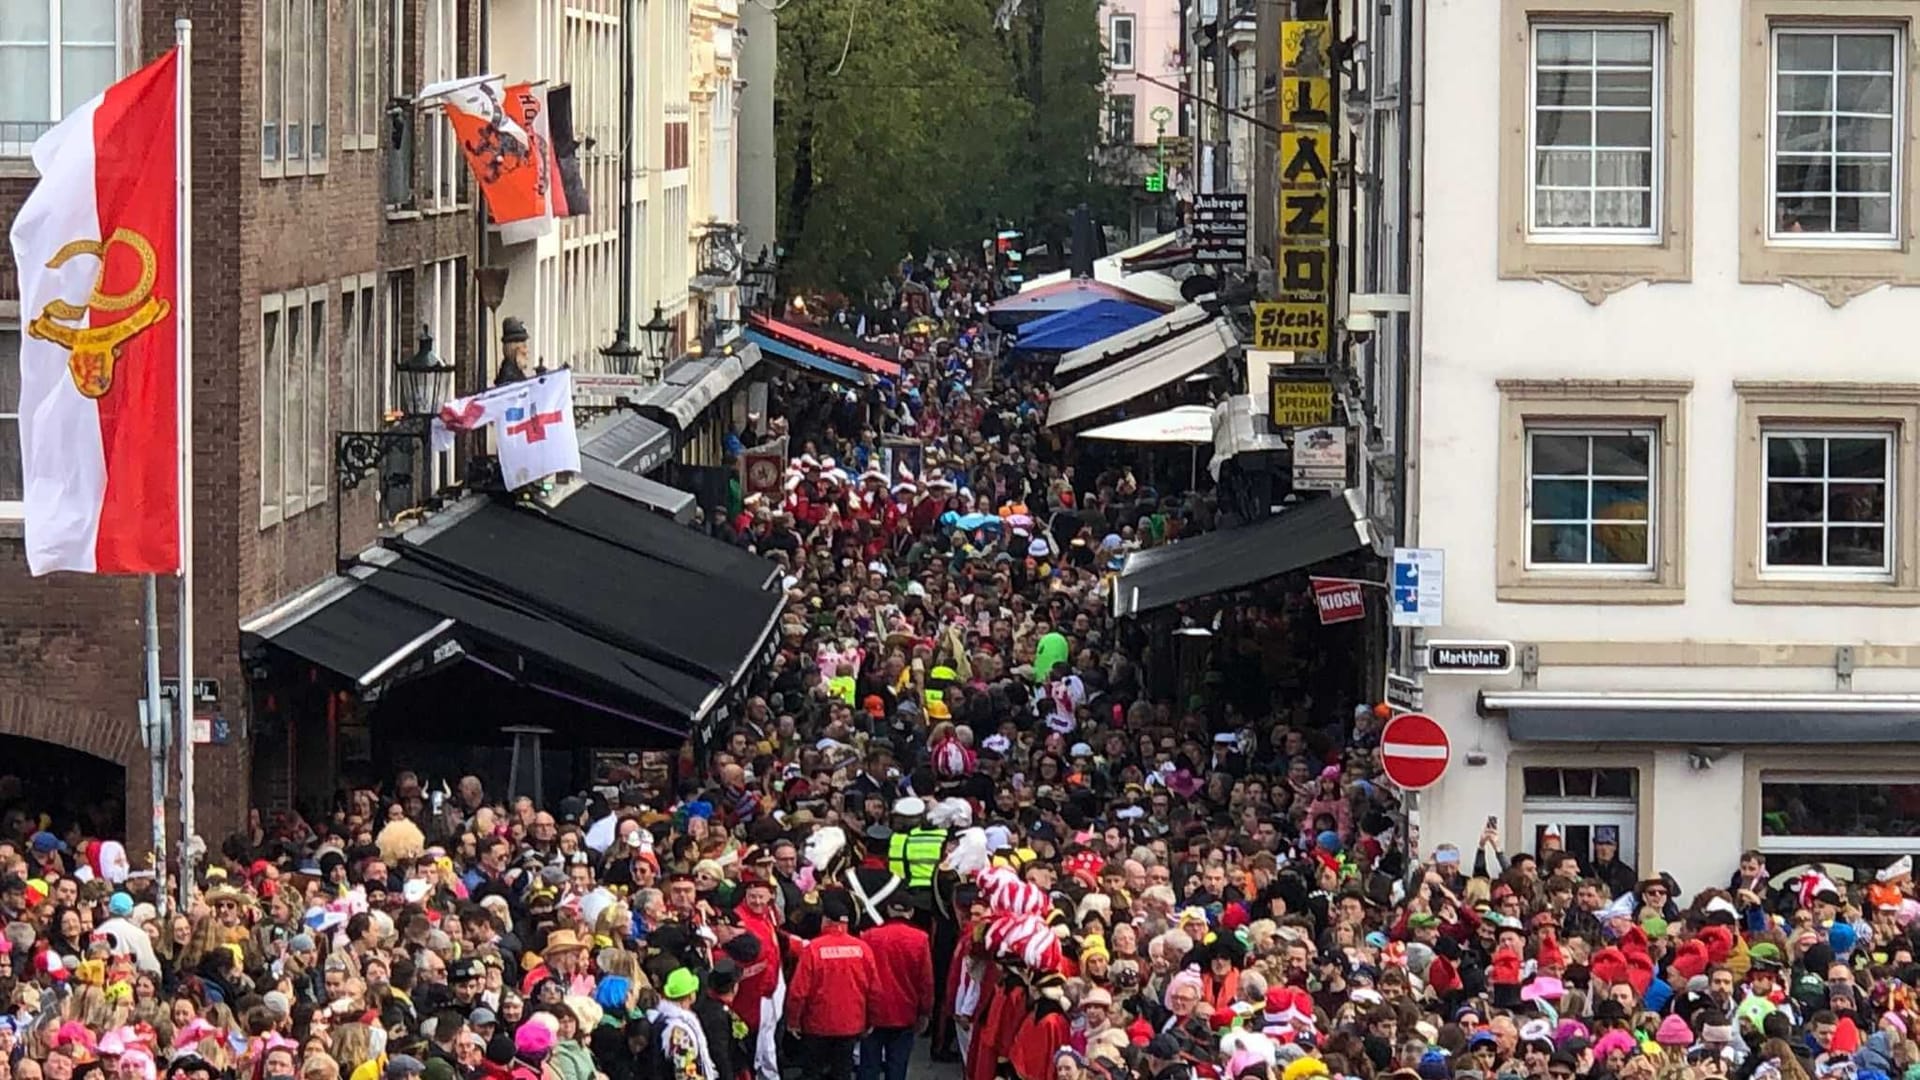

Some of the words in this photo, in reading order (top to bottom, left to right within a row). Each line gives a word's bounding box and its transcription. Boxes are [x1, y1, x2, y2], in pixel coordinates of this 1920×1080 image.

[1194, 195, 1244, 211] Auberge
[1260, 308, 1324, 328] Steak
[1261, 328, 1320, 348] Haus
[1319, 590, 1361, 611] KIOSK
[1439, 650, 1500, 667] Marktplatz
